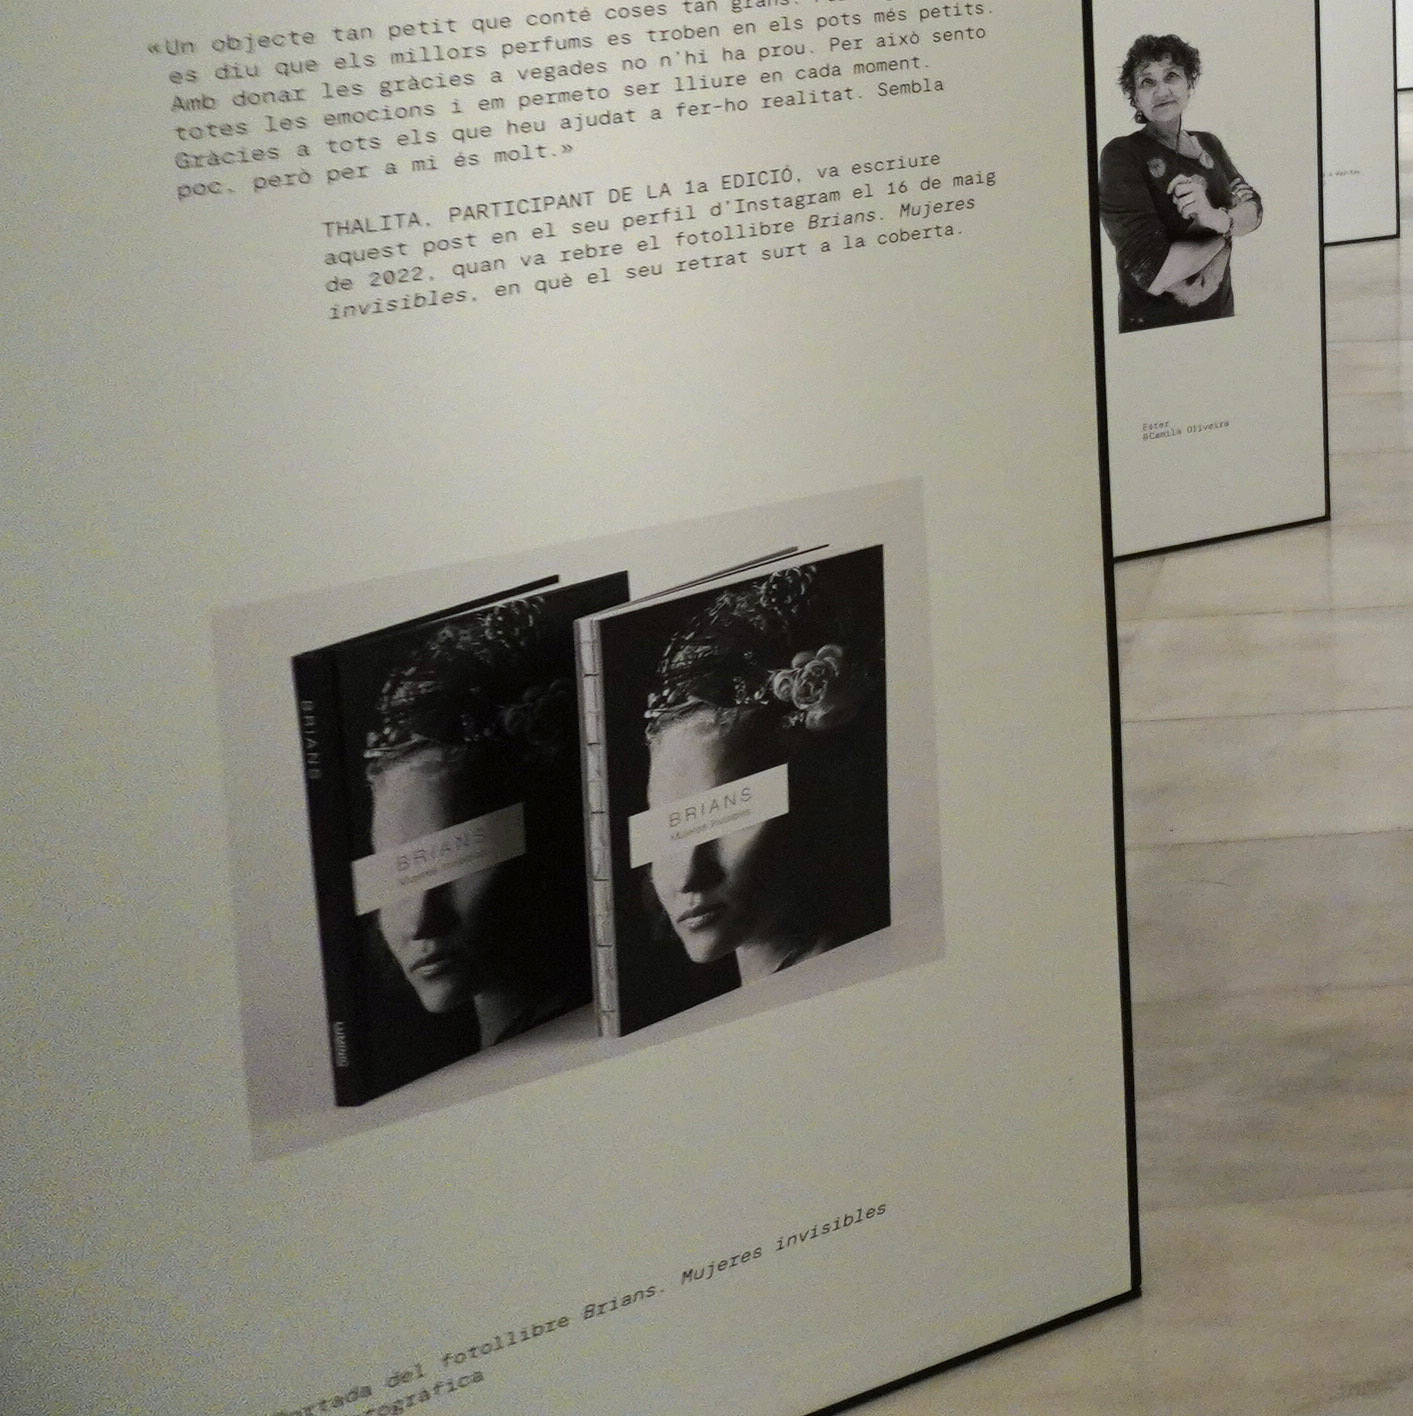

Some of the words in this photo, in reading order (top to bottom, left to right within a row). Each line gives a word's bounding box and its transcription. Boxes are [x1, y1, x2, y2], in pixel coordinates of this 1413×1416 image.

[211, 30, 315, 54] objecte
[332, 26, 373, 42] tan
[388, 18, 456, 41] petit
[471, 16, 512, 34] que
[525, 6, 591, 26] conté
[604, 3, 667, 20] coses
[681, 0, 718, 14] tan
[322, 211, 431, 238] THALITA,
[448, 190, 595, 223] PARTICIPANT
[608, 186, 632, 204] DE
[646, 182, 672, 199] LA
[685, 179, 709, 195] 1a
[721, 164, 801, 190] EDICIÓ,
[816, 165, 840, 178] va
[851, 154, 940, 175] escriure
[668, 787, 753, 827] BRIANS
[384, 1362, 426, 1388] del
[440, 1315, 570, 1368] fotollibre
[582, 1285, 664, 1320] Brians.
[681, 1246, 762, 1285] Mujeres
[775, 1203, 886, 1251] invisibles
